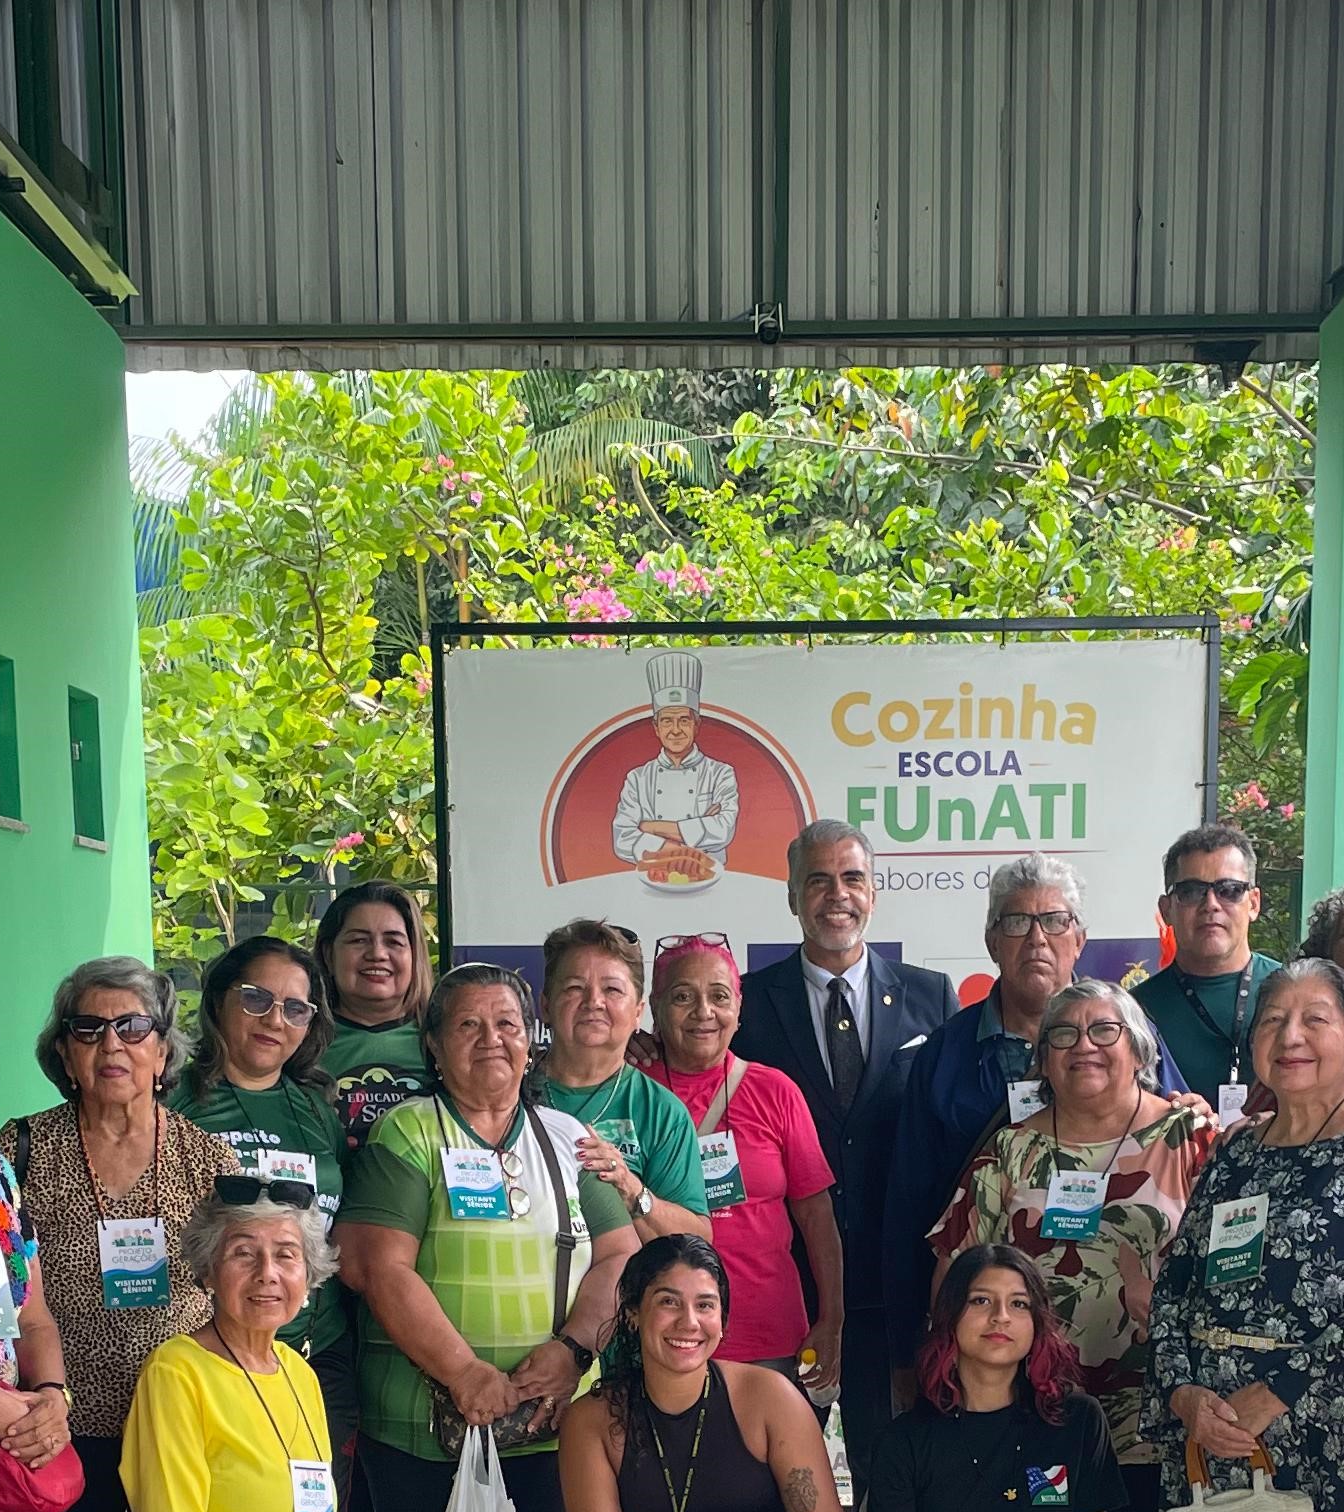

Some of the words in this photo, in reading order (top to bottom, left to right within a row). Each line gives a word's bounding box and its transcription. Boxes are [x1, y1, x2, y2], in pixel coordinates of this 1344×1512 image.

[831, 683, 1097, 747] Cozinha
[898, 750, 1022, 778] ESCOLA
[847, 783, 1087, 842] FUnATI
